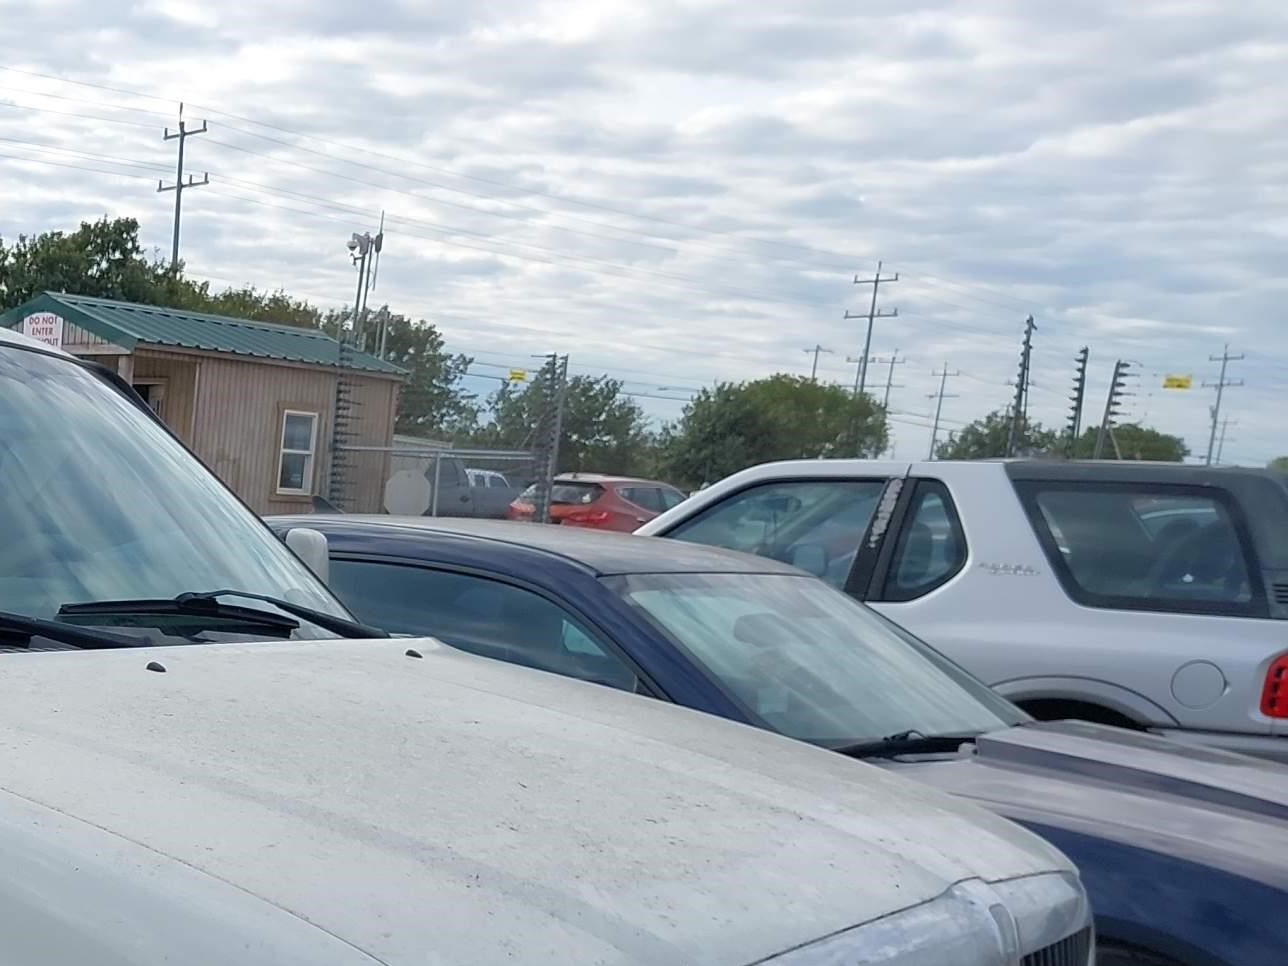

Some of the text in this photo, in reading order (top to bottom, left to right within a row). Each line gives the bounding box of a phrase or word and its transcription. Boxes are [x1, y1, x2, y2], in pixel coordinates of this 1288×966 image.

[28, 316, 58, 325] DO NOT
[32, 327, 54, 336] ENTER
